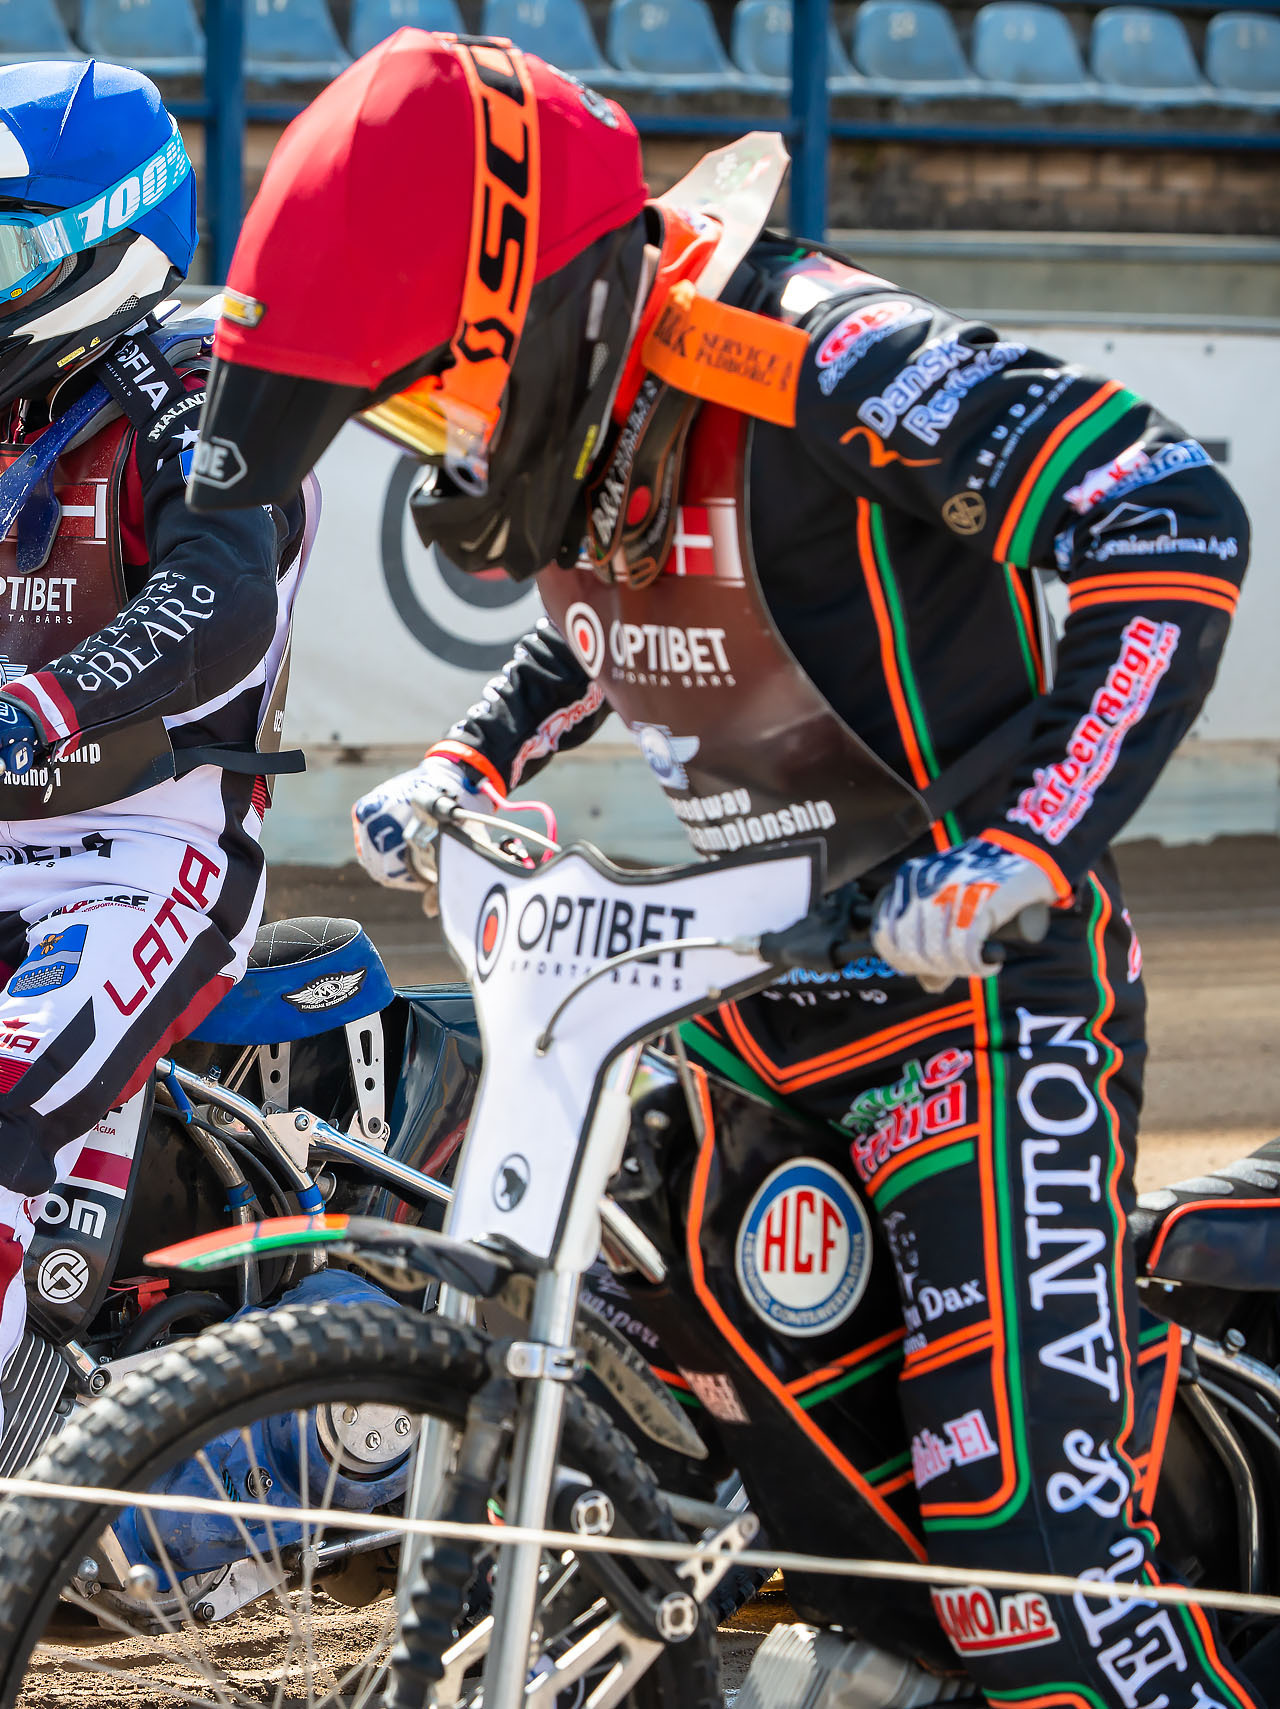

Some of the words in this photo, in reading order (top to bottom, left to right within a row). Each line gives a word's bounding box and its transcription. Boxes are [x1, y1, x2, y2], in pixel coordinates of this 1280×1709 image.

[78, 133, 186, 243] 100%
[86, 598, 213, 690] BEAR
[610, 620, 731, 672] OPTIBET
[54, 768, 61, 786] 1
[518, 893, 694, 968] OPTIBET
[764, 1190, 842, 1273] HCF
[1016, 1006, 1119, 1402] ANTON
[921, 1278, 985, 1320] Dax
[1046, 1429, 1130, 1518] &
